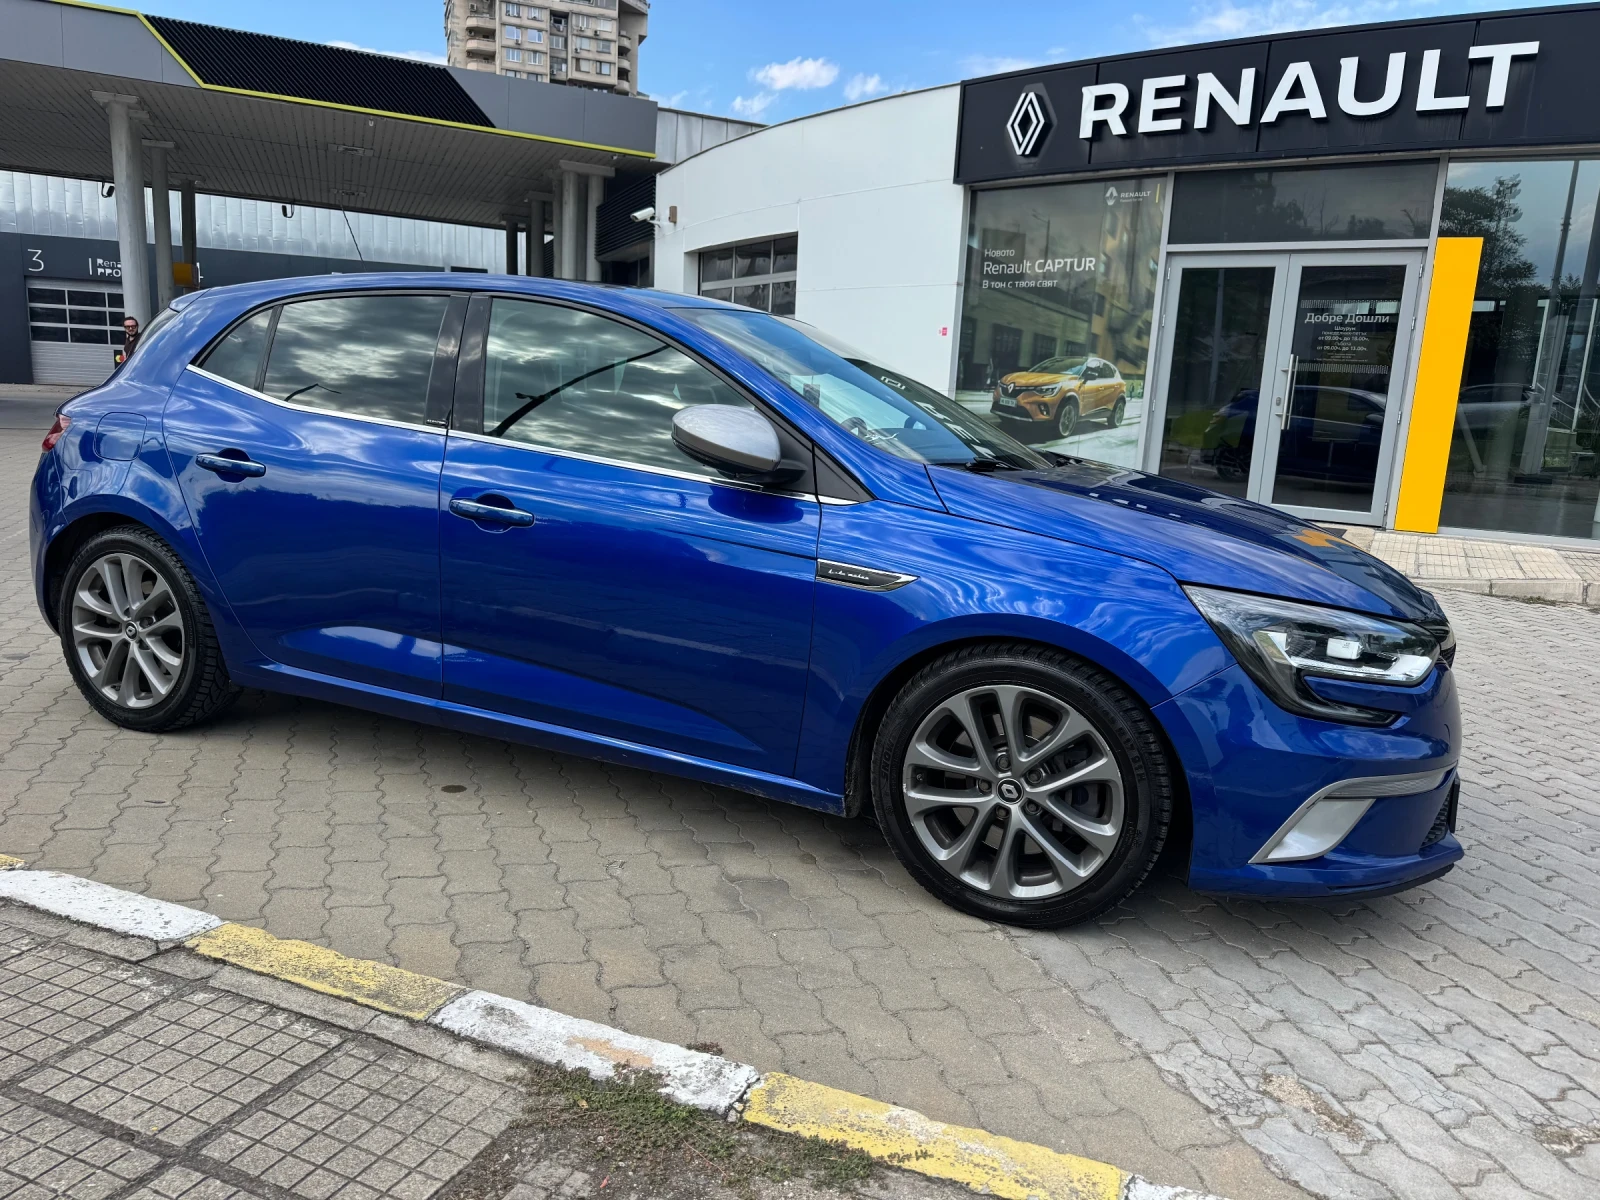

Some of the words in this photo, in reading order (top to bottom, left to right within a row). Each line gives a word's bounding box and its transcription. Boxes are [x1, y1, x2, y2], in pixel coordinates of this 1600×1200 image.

[1079, 41, 1540, 140] RENAULT
[984, 249, 1015, 257] Новото
[27, 249, 45, 272] 3
[97, 258, 121, 267] Rena
[983, 260, 1032, 275] Renault
[1034, 257, 1096, 272] CAPTUR
[982, 280, 989, 288] В
[1014, 280, 1035, 288] твоя
[1036, 280, 1058, 288] свят
[1304, 313, 1343, 324] Добре
[1344, 313, 1390, 324] Дошли
